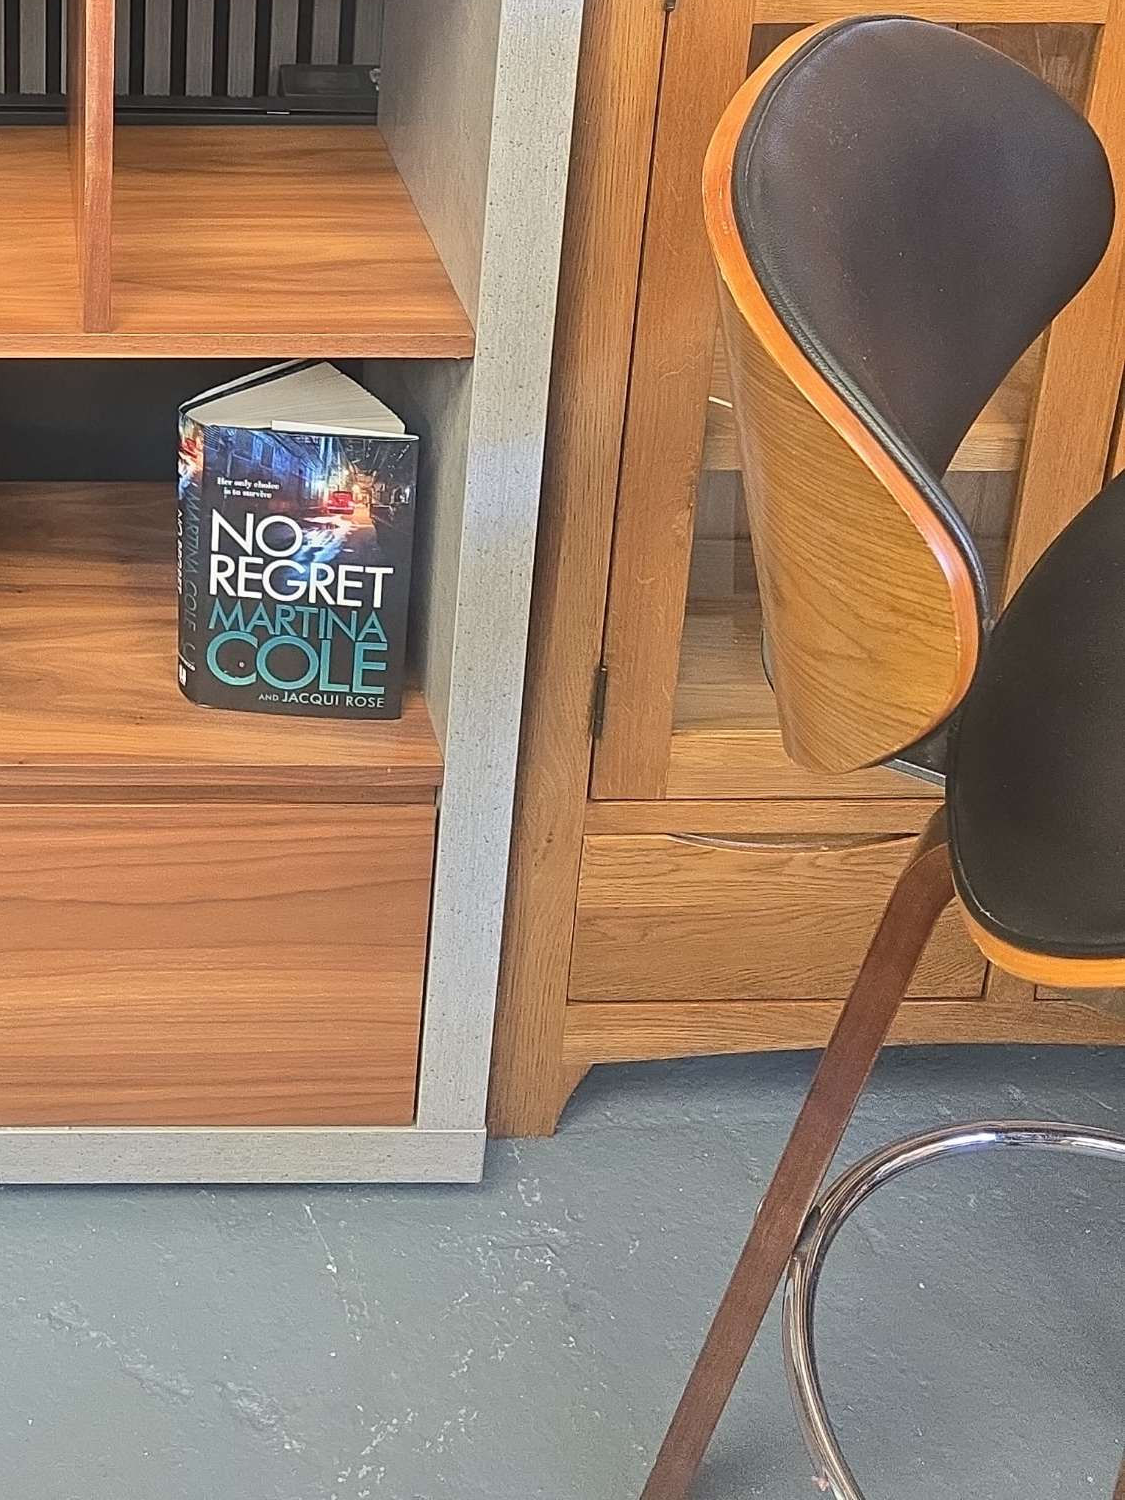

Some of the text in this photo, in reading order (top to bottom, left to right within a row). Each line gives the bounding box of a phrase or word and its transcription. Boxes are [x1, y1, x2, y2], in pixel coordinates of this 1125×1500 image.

[217, 476, 280, 490] Her only choice
[242, 490, 273, 499] survive
[212, 509, 304, 558] NO
[183, 490, 201, 632] MARTINA COLE
[208, 554, 394, 609] REGRET
[208, 597, 388, 643] MARTINA
[206, 631, 389, 695] COLE
[258, 691, 385, 708] AND JACQUI ROSE
